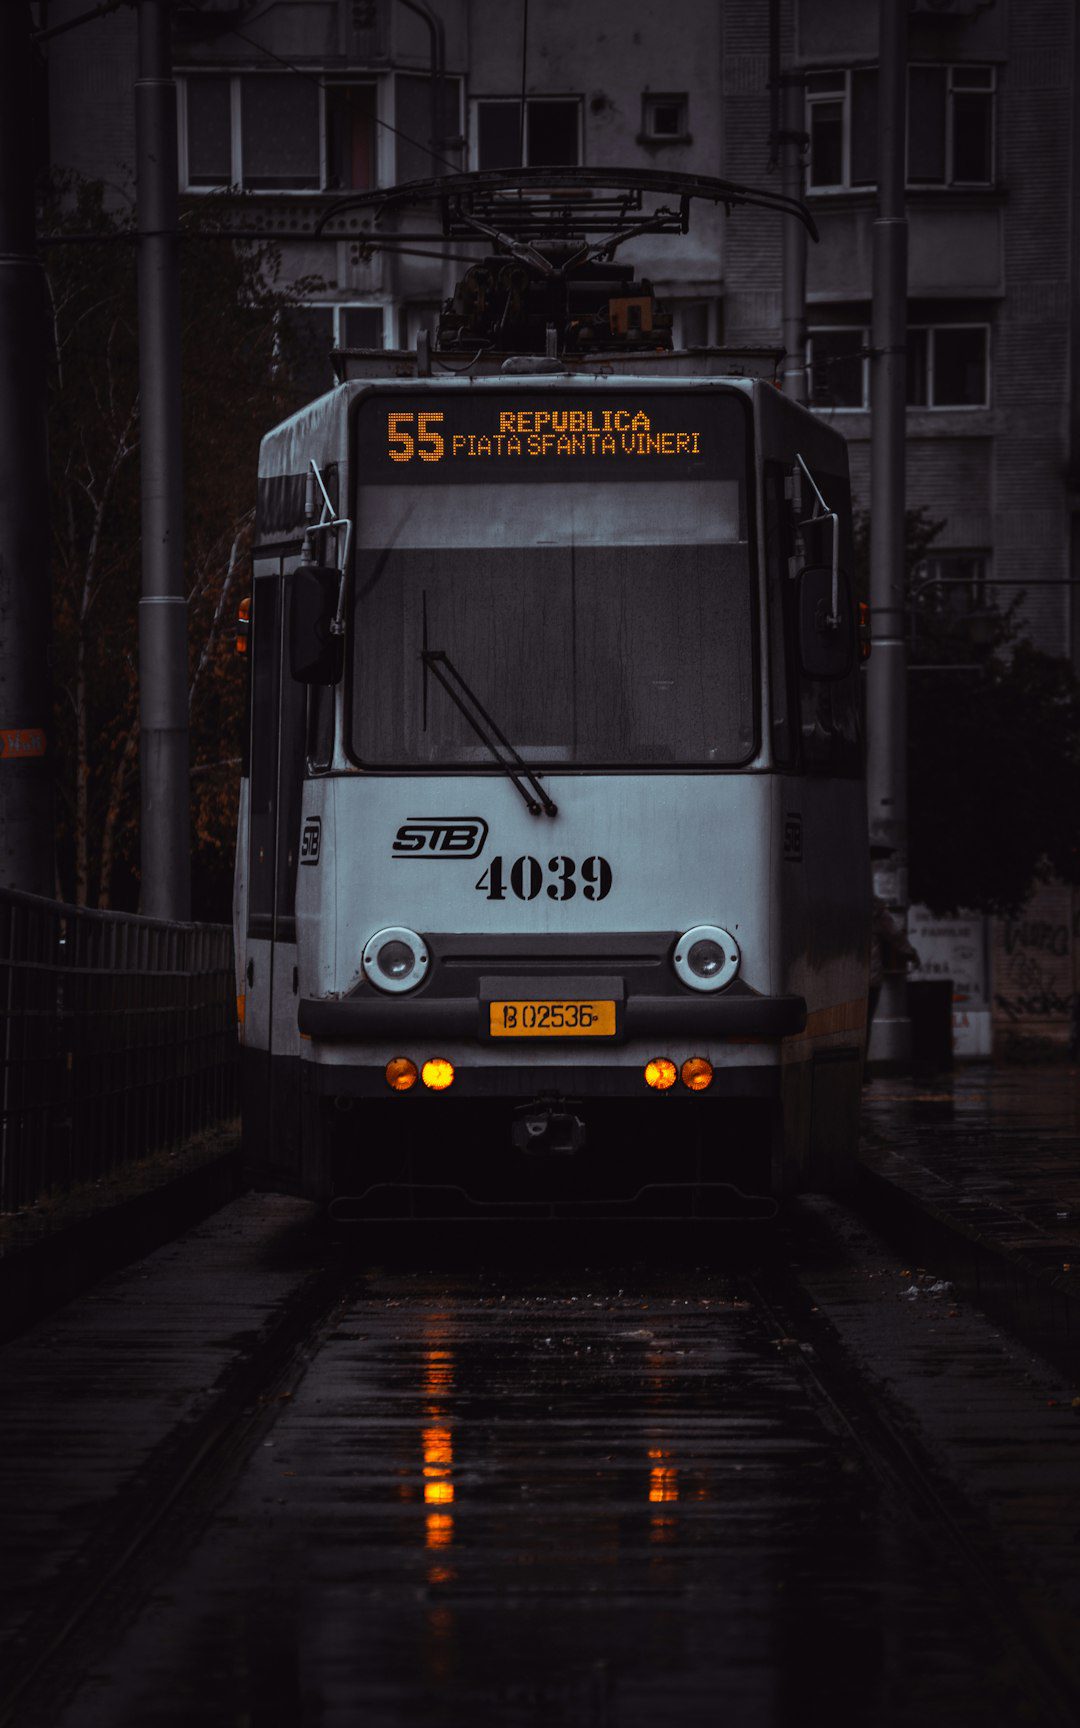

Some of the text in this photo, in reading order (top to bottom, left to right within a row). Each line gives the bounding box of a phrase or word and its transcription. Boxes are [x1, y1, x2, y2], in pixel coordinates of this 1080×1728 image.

[500, 410, 651, 432] REPUBLICA
[388, 412, 444, 462] 55
[452, 432, 700, 456] PIATA SFANTA VINERI
[302, 825, 320, 856] STB
[392, 824, 480, 852] STB
[475, 855, 613, 901] 4039
